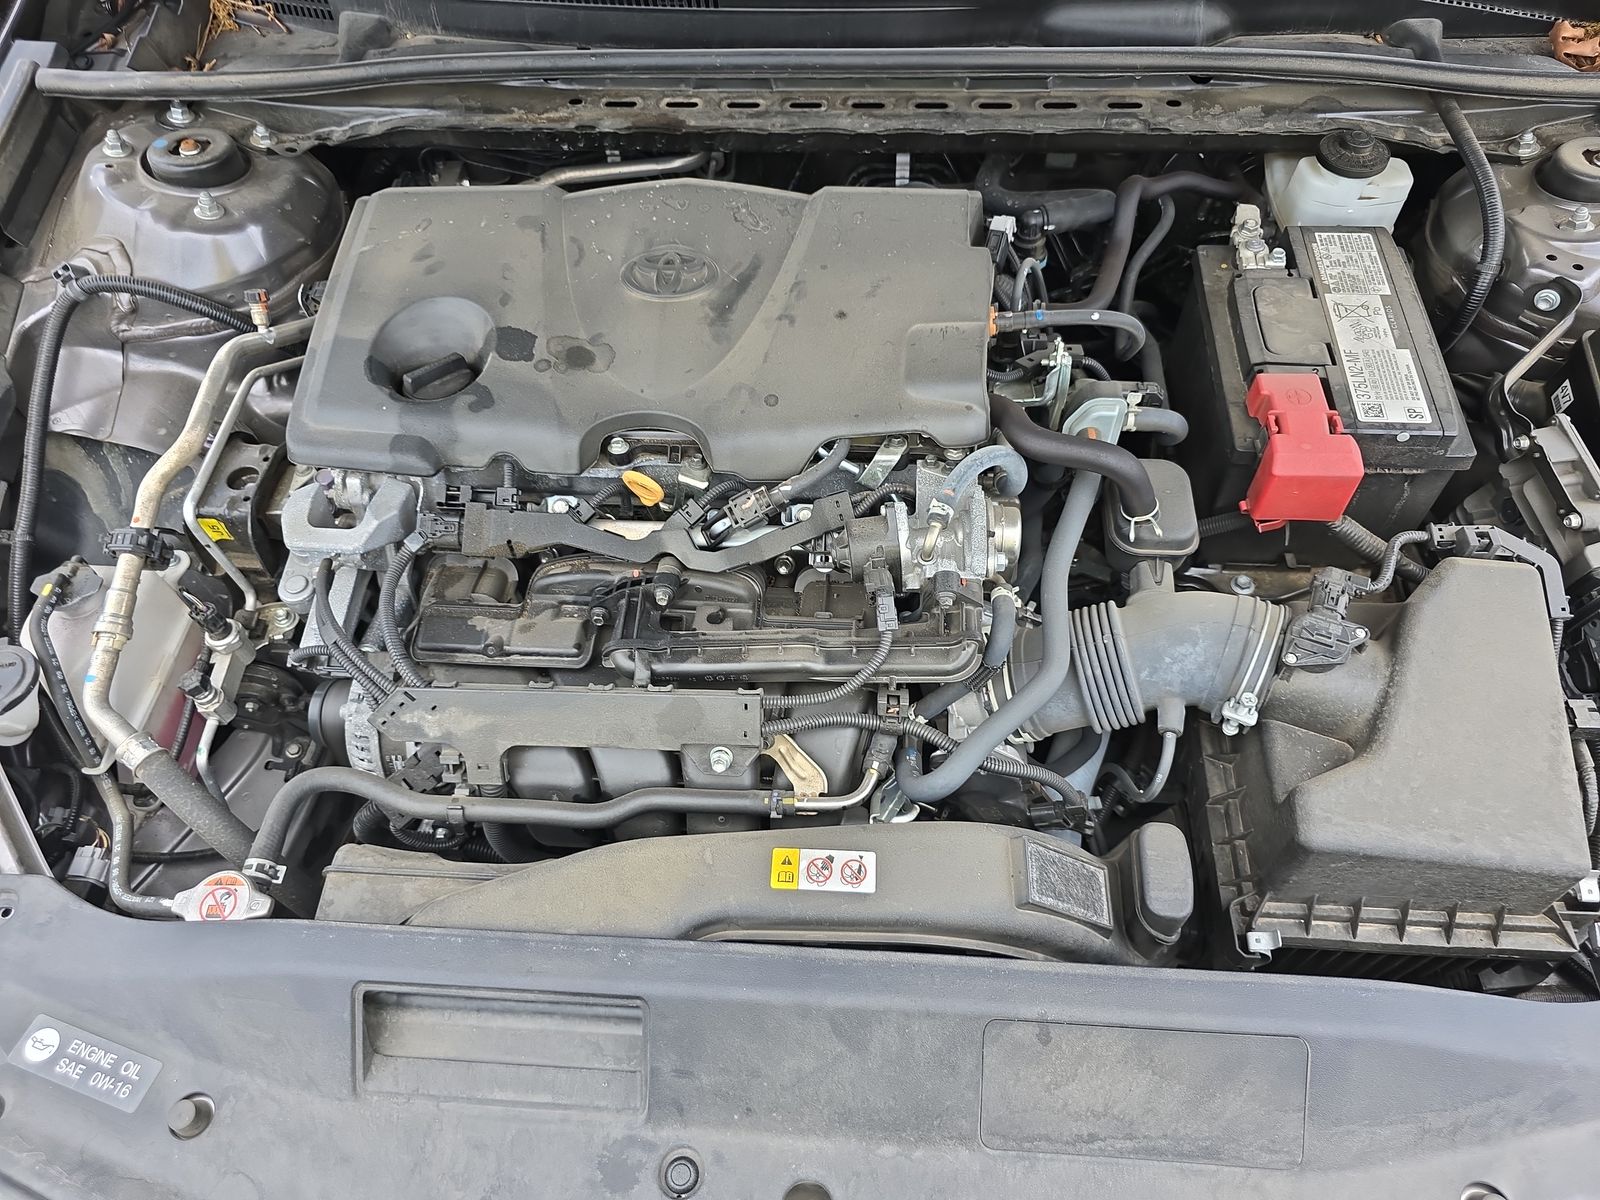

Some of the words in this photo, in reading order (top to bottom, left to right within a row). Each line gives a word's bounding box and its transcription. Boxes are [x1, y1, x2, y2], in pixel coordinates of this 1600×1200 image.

[1385, 305, 1397, 330] CLARIOS
[1343, 349, 1371, 400] 375LN2-MF
[1560, 385, 1572, 405] 4V7
[1407, 408, 1424, 419] SP
[67, 1039, 118, 1068] ENGINE
[121, 1061, 142, 1080] OIL
[55, 1058, 86, 1079] SAE
[90, 1071, 133, 1098] 0W-16
